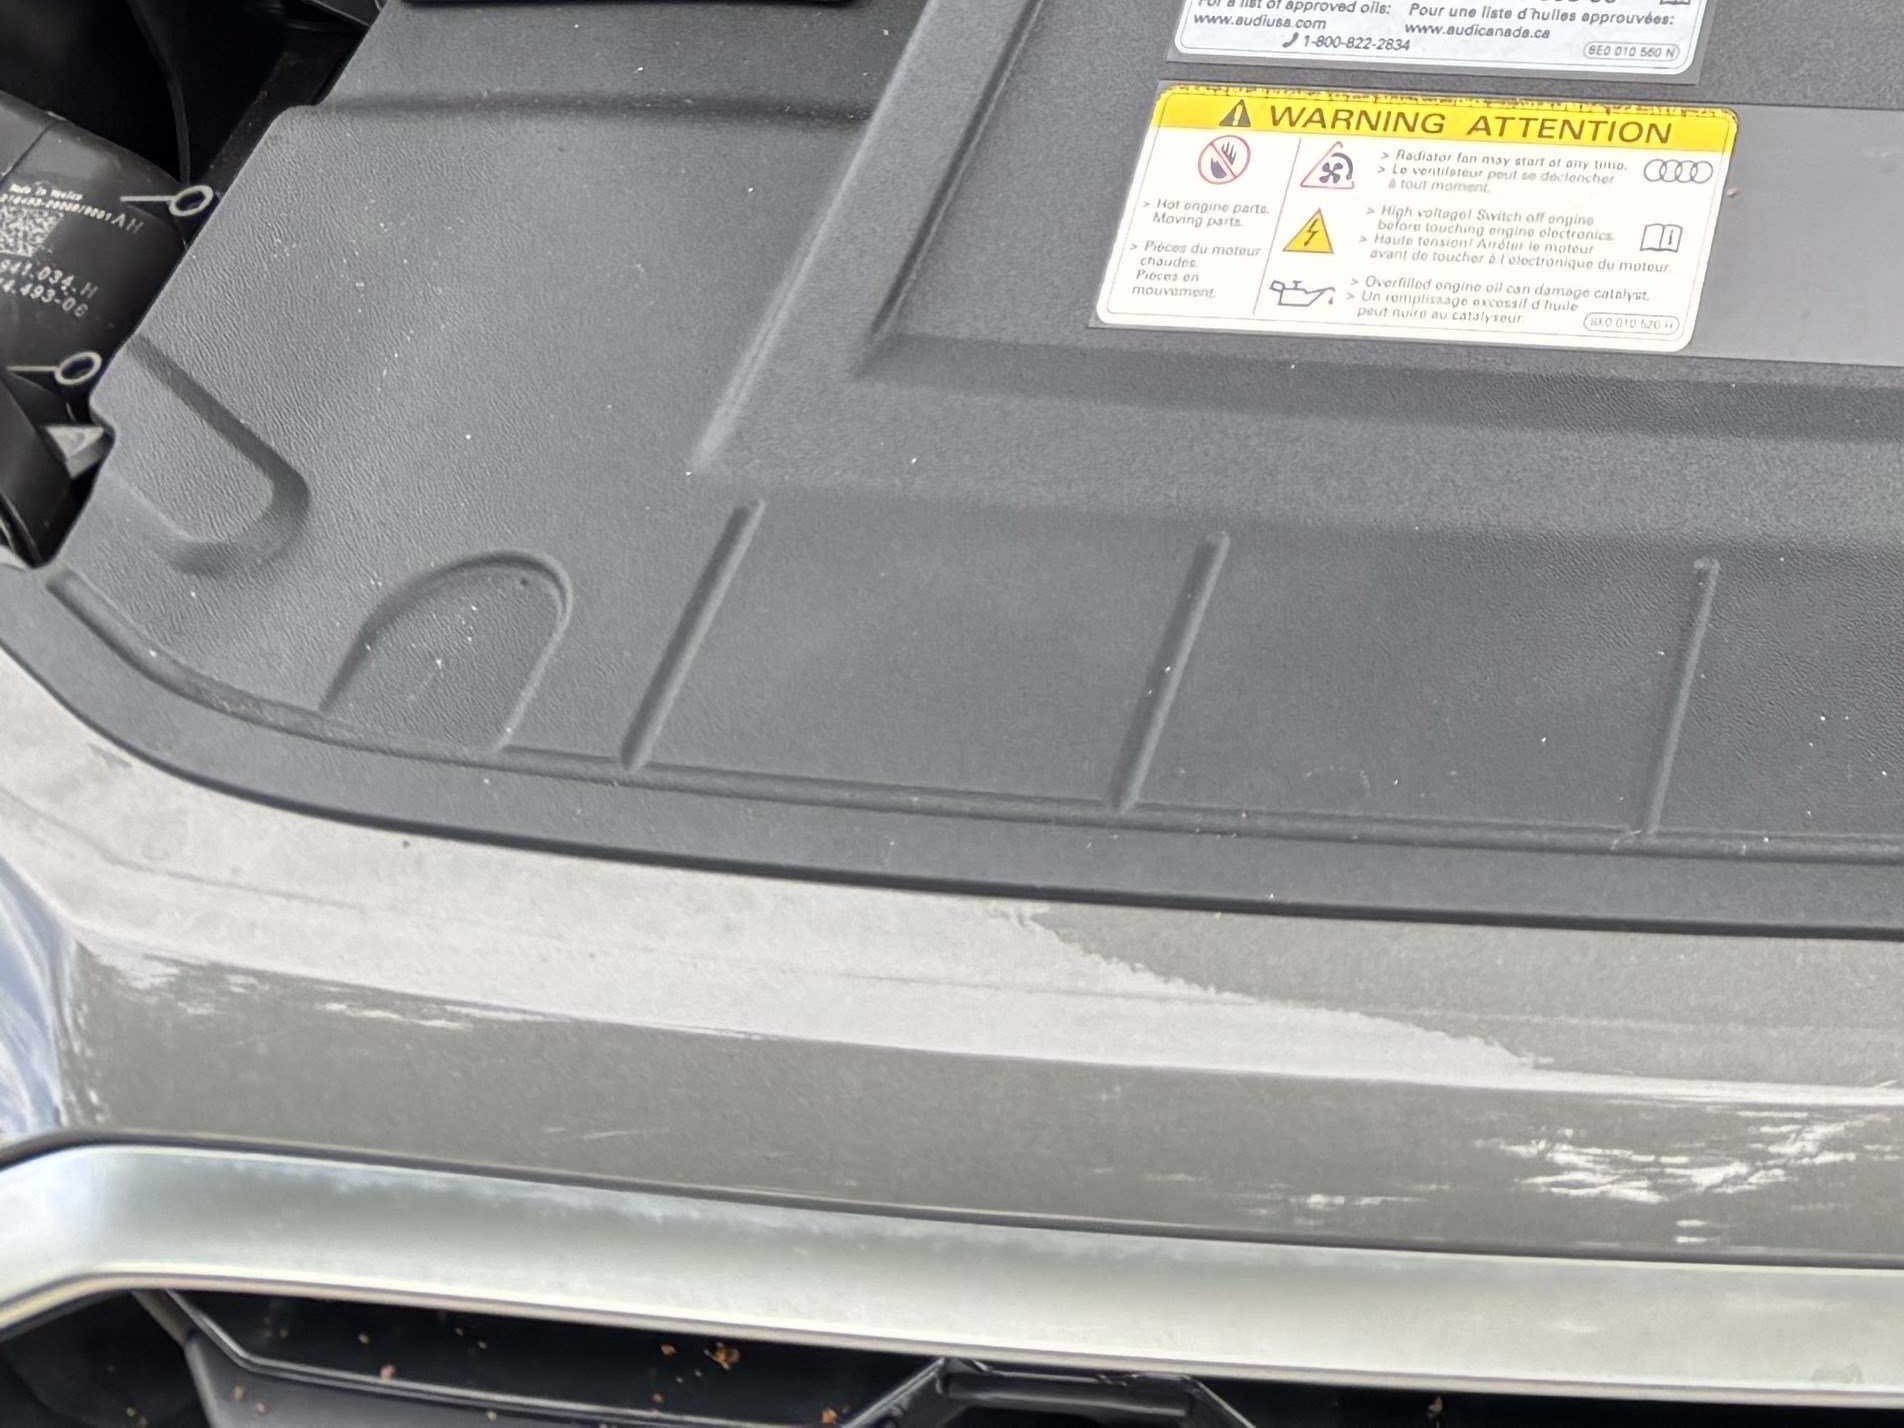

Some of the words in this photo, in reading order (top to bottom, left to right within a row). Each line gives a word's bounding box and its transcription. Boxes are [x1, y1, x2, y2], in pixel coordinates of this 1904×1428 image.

[1287, 0, 1356, 14] approved
[1360, 2, 1392, 15] oils:
[1409, 4, 1445, 17] Pour
[1449, 7, 1477, 18] une
[1482, 5, 1512, 19] liste
[1581, 11, 1674, 26] approuvées:
[1194, 14, 1326, 29] www.audiusa.com
[1405, 23, 1550, 38] www.audicanada.ca
[1303, 35, 1410, 51] 1-800-822-2834
[1614, 47, 1636, 57] 010
[1269, 105, 1444, 134] WARNING
[1466, 112, 1672, 144] ATTENTION
[1396, 149, 1452, 162] Radiator
[1457, 152, 1477, 163] fan
[1482, 156, 1510, 167] may
[1515, 157, 1545, 166] start
[1549, 159, 1561, 167] at
[1566, 160, 1589, 170] any
[1595, 160, 1627, 171] time.
[1392, 164, 1407, 174] Le
[1413, 165, 1483, 177] ventilateur
[1487, 170, 1517, 180] peut
[1522, 171, 1536, 180] se
[1400, 180, 1426, 189] tout
[1431, 182, 1490, 193] moment.
[1157, 198, 1180, 210] Hot
[1184, 202, 1229, 214] engine
[1232, 204, 1270, 214] parts.
[1152, 212, 1202, 226] Moving
[1207, 216, 1244, 228] parts.
[1382, 205, 1412, 220] High
[1418, 208, 1472, 221] voltage!
[1477, 209, 1521, 222] Switch
[1526, 212, 1545, 223] off
[1548, 215, 1594, 227] engine
[1378, 219, 1421, 232] before
[1425, 221, 1484, 237] touching
[1489, 224, 1535, 238] engine
[1539, 228, 1615, 241] electronics.
[1192, 243, 1208, 254] du
[1212, 245, 1261, 256] moteur
[1374, 233, 1413, 244] Haute
[1418, 235, 1473, 247] tension!
[1529, 241, 1540, 251] le
[1545, 243, 1594, 254] moteur
[1140, 256, 1198, 268] chaudes.
[1370, 249, 1407, 260] avant
[1412, 250, 1428, 261] de
[1433, 252, 1483, 263] toucher
[1598, 259, 1614, 270] du
[1619, 262, 1671, 273] moteur.
[1183, 273, 1199, 282] en
[1366, 275, 1431, 289] Overfilled
[1435, 281, 1481, 293] engine
[1486, 281, 1502, 293] oil
[1506, 284, 1530, 294] can
[1535, 284, 1590, 299] damage
[1362, 290, 1380, 301] Un
[1386, 294, 1467, 308] remplissage
[1473, 298, 1527, 309] excessif
[1358, 307, 1387, 318] peut
[1393, 308, 1426, 319] nuire
[1431, 309, 1447, 320] au
